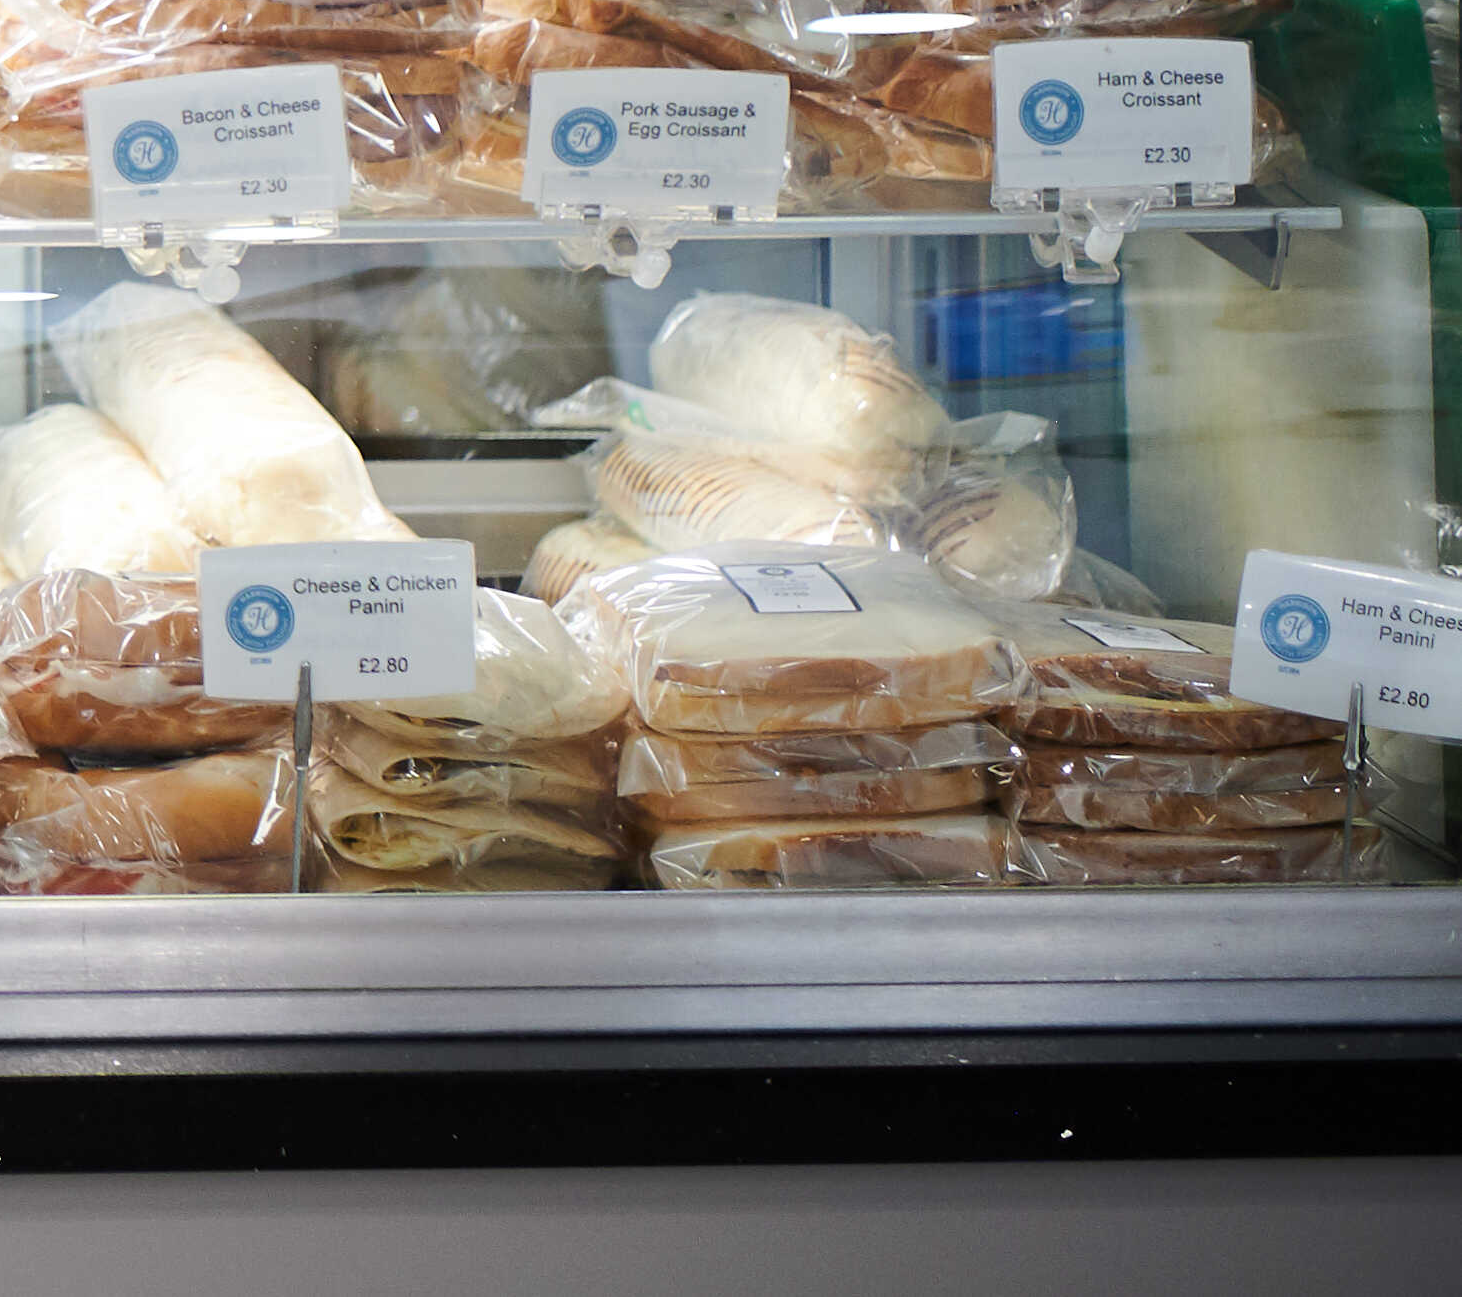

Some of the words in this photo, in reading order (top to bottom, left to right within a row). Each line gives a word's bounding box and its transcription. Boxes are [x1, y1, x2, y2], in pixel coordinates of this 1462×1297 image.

[1098, 72, 1137, 86] Ham
[1143, 71, 1154, 86] &
[1160, 70, 1224, 85] Cheese
[1122, 92, 1201, 108] Croissant
[182, 109, 234, 125] Bacon
[240, 104, 252, 118] &
[257, 99, 320, 116] Cheese
[621, 102, 659, 116] Pork
[665, 102, 739, 121] Sausage
[744, 103, 756, 118] &
[214, 121, 294, 142] Croissant
[628, 122, 660, 139] Egg
[667, 122, 746, 137] Croissant
[1145, 147, 1191, 163] £2.30
[241, 179, 287, 196] £2.30
[662, 173, 710, 189] £2.30
[293, 578, 361, 594] Cheese
[368, 576, 380, 592] &
[386, 575, 456, 591] Chicken
[350, 599, 404, 614] Panini
[1342, 597, 1383, 618] Ham
[1390, 605, 1402, 621] &
[1408, 608, 1462, 631] Chees
[1380, 621, 1435, 649] Panini
[359, 657, 408, 673] £2.80
[1379, 686, 1429, 708] £2.80
